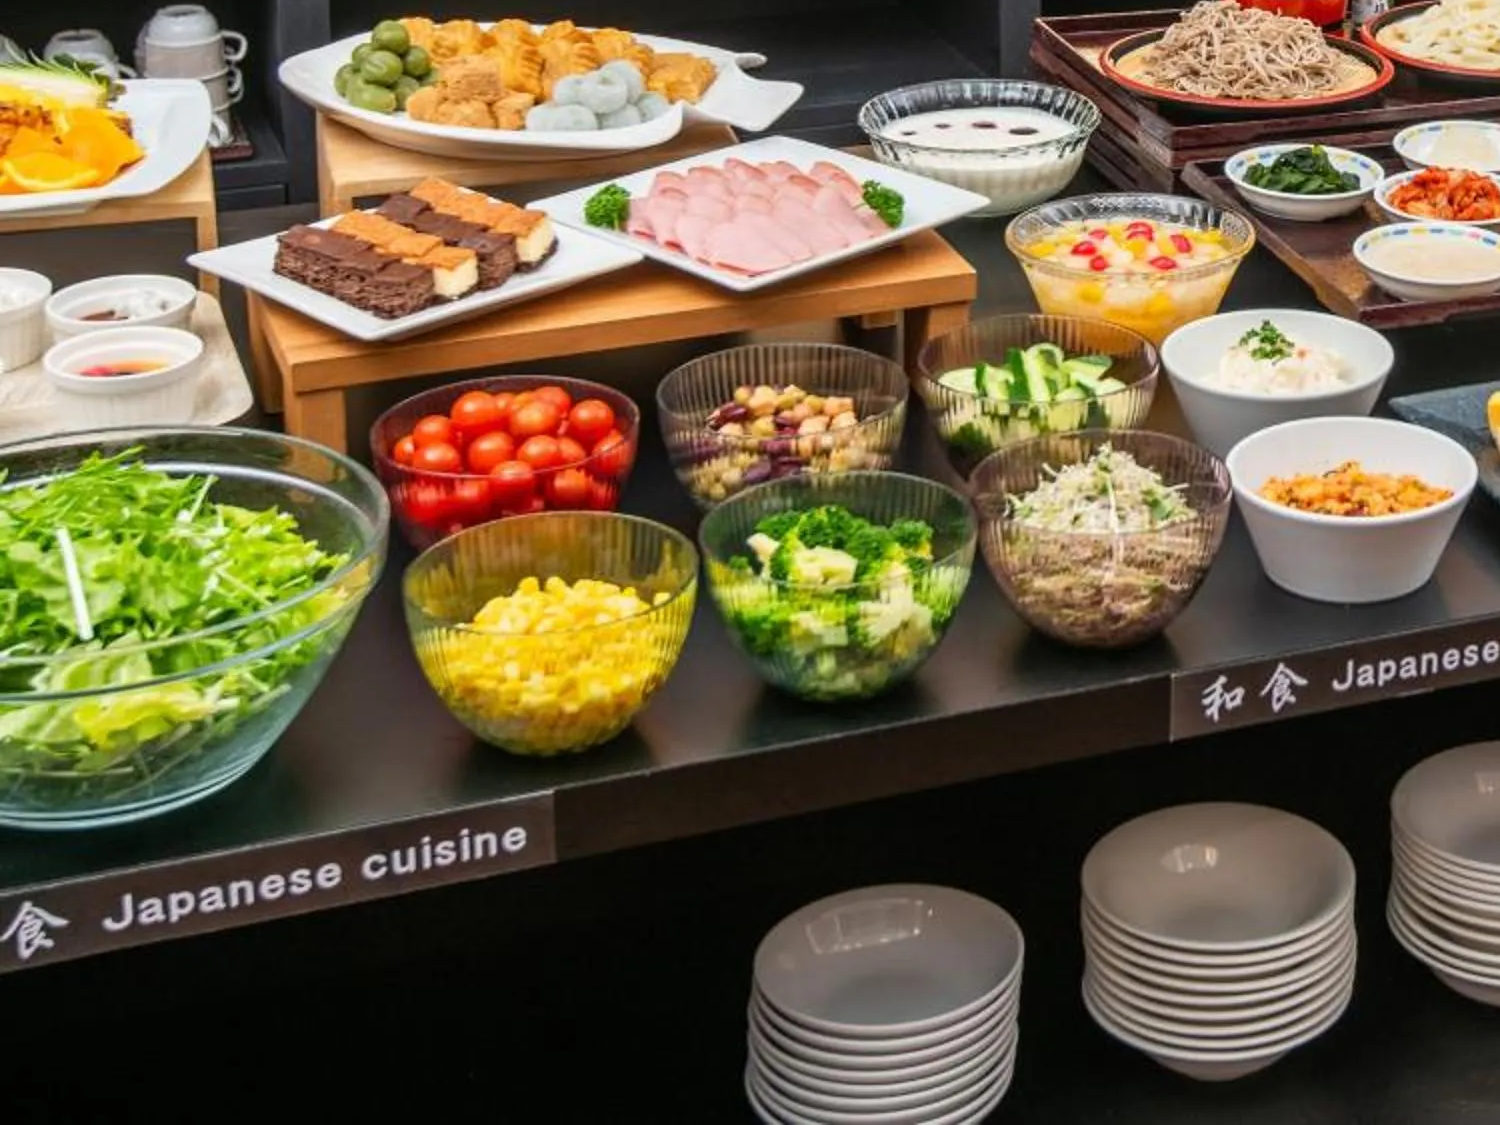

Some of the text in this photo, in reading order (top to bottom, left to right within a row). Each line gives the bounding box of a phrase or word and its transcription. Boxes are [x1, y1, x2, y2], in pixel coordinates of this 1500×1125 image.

[1201, 661, 1309, 723] 和食
[1331, 638, 1500, 692] Japanese
[0, 824, 528, 960] 食 Japanese cuisine
